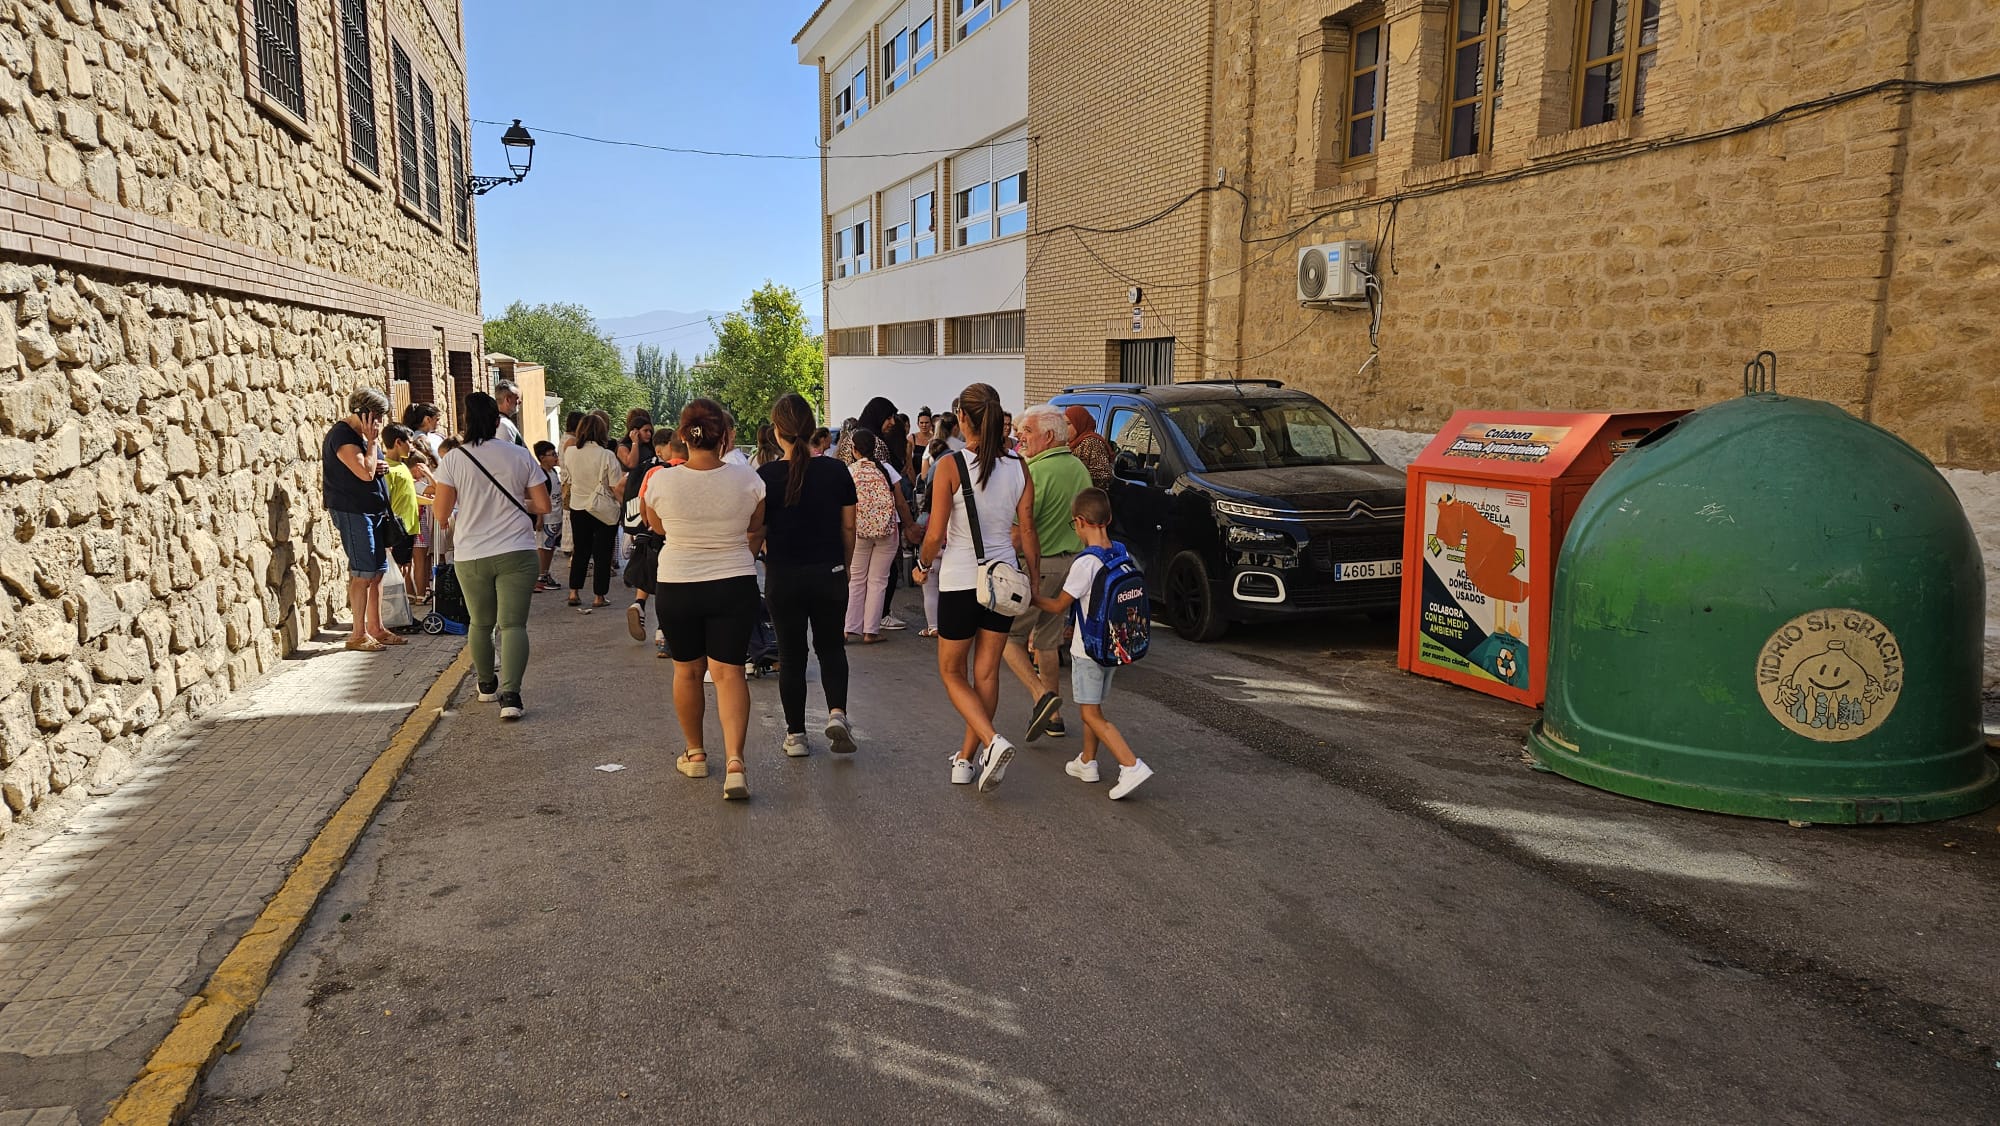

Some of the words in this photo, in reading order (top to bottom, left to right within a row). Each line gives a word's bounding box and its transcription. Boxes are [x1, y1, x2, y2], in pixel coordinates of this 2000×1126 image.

[1485, 429, 1533, 440] Colabora
[1483, 441, 1550, 456] Ayuntamiento
[1343, 564, 1375, 578] 4605
[1380, 562, 1402, 576] LJB
[1456, 591, 1485, 605] USADOS
[1429, 602, 1464, 619] COLABORA
[1425, 612, 1438, 623] CON
[1438, 615, 1446, 625] EL
[1447, 617, 1469, 630] MEDIO
[1430, 624, 1463, 640] AMBIENTE
[1431, 653, 1451, 663] nuestra
[1760, 625, 1804, 685] VIDRIO
[1843, 613, 1900, 693] GRACIAS
